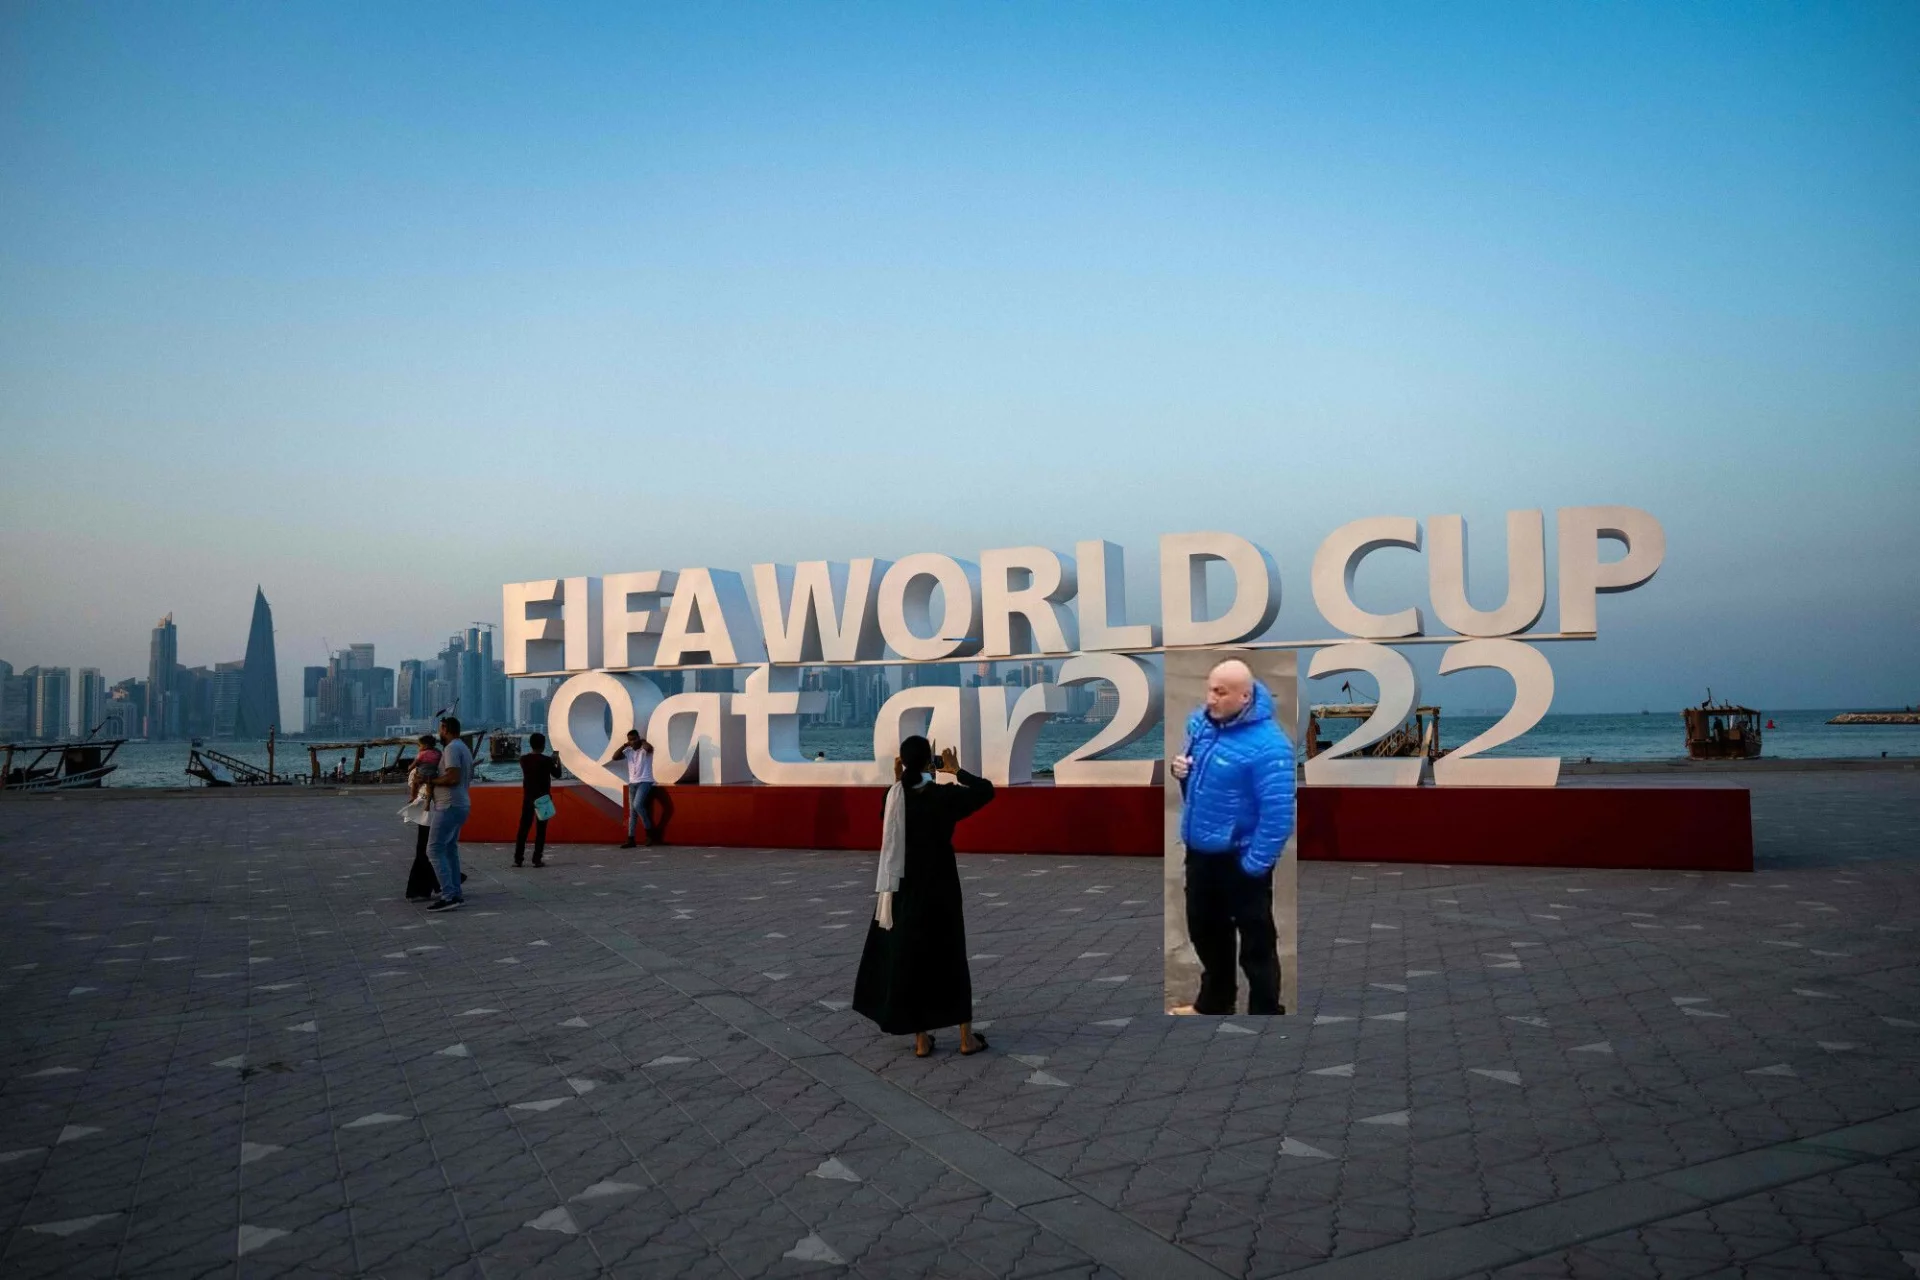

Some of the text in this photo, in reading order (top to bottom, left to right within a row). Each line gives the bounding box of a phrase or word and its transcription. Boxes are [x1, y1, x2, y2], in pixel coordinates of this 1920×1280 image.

[503, 506, 1666, 675] FIFA WORLD CUP
[1054, 637, 1561, 786] 222
